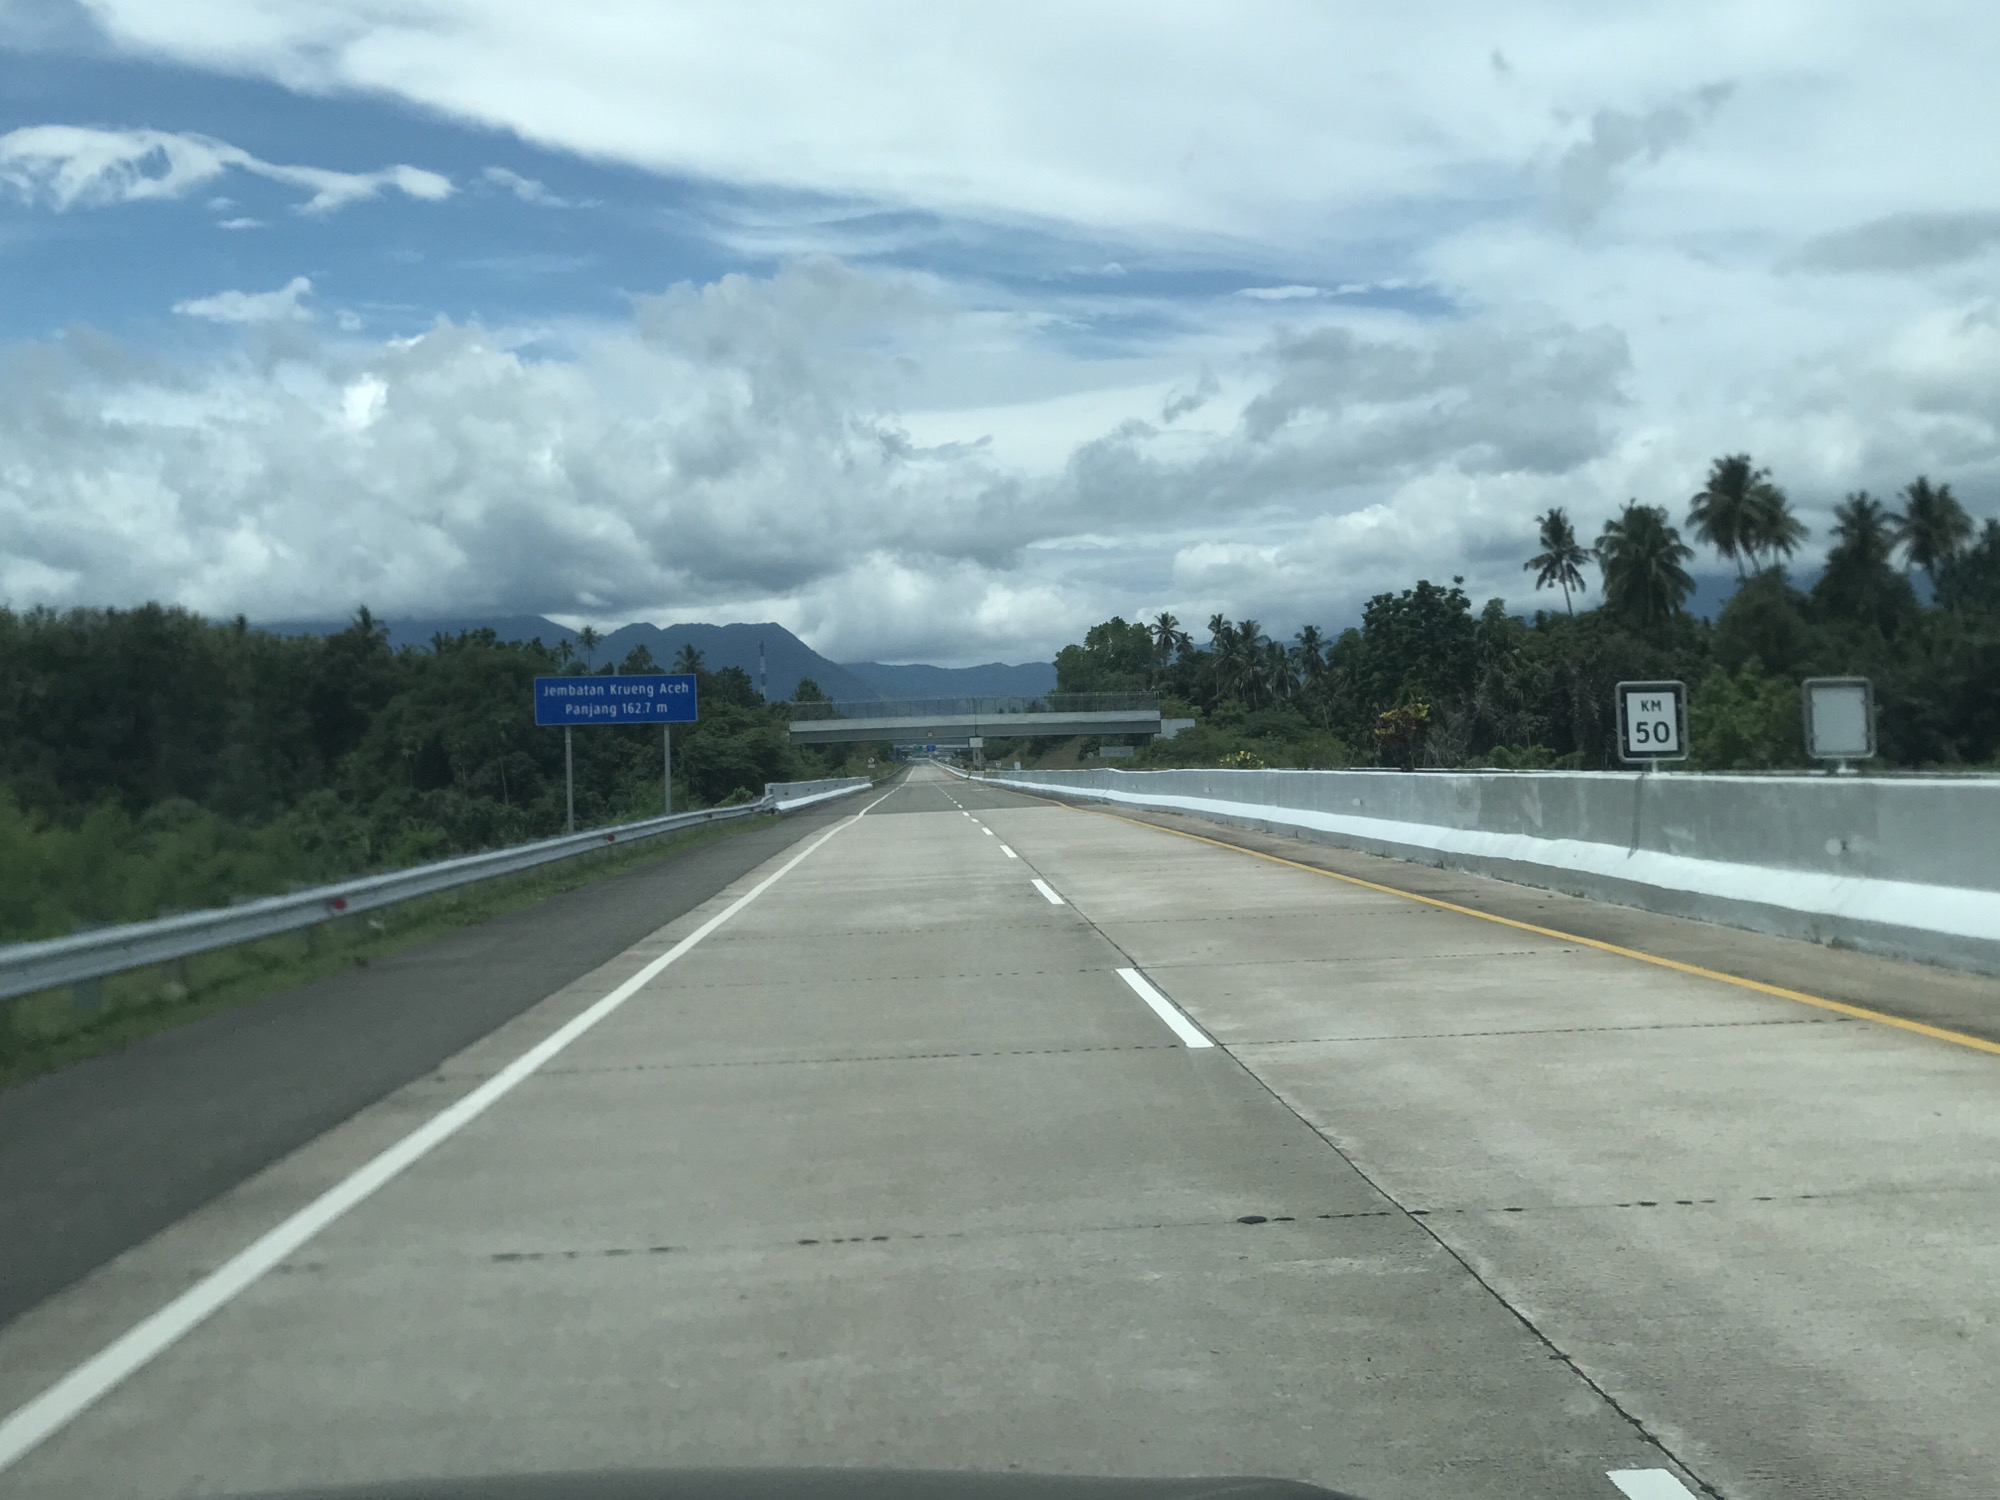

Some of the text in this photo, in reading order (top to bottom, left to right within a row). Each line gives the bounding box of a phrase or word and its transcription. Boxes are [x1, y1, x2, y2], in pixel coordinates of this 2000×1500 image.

[543, 681, 689, 697] Jembatan Krueng Aceh
[565, 702, 668, 718] Panjang 162.7 m
[1640, 700, 1662, 712] KM
[1636, 721, 1670, 744] 50
